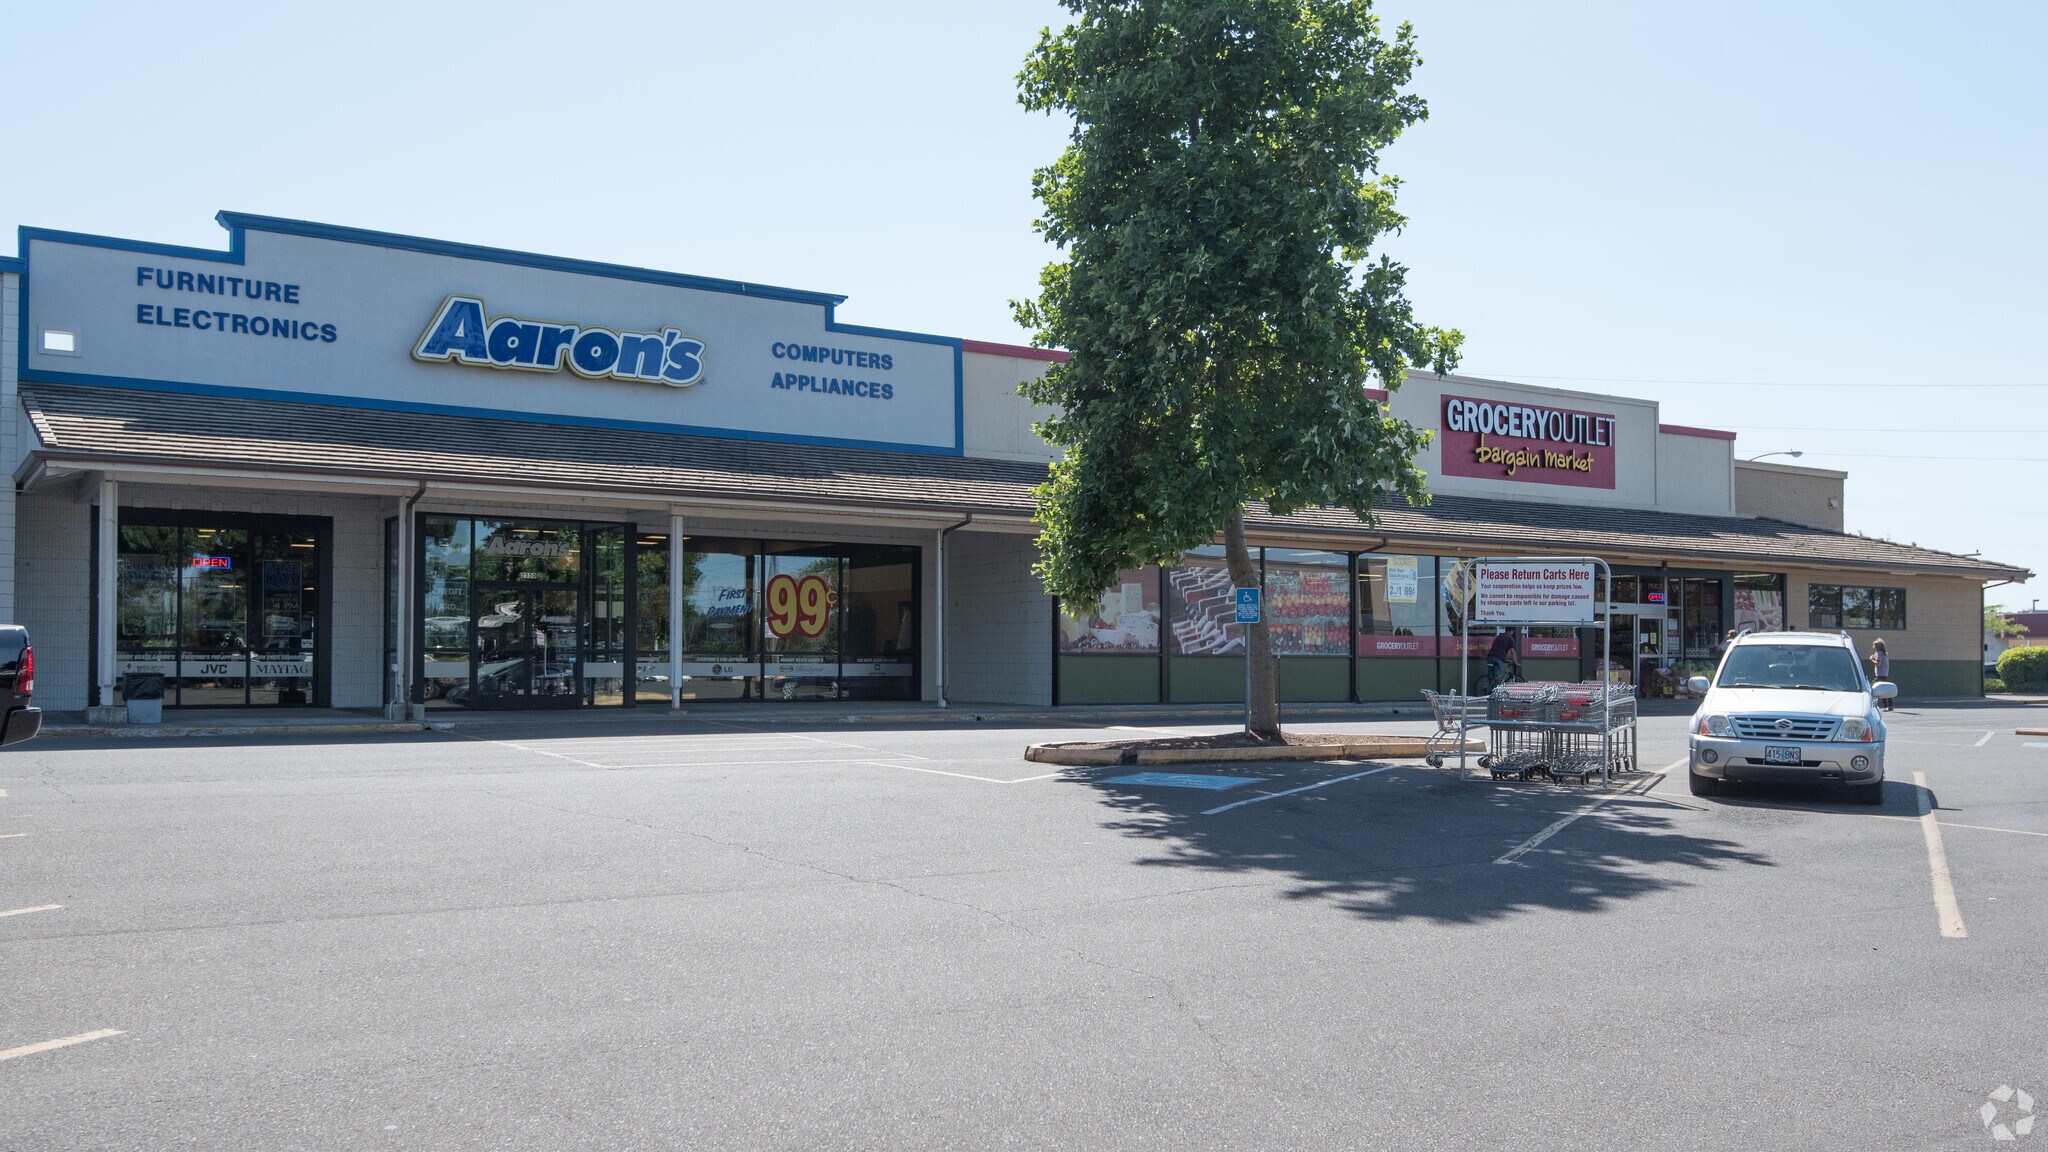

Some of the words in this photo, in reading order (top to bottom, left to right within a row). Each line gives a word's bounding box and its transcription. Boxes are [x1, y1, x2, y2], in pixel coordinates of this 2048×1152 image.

[137, 266, 300, 304] FURNITURE
[136, 303, 337, 343] ELECTRONICS
[413, 294, 705, 387] Aaron's
[771, 341, 893, 371] COMPUTERS
[770, 372, 894, 400] APPLIANCES
[1447, 399, 1616, 447] GROCERYOUTLET
[1475, 432, 1540, 476] bargain
[1544, 448, 1594, 473] market
[487, 534, 569, 557] Aaron's
[192, 557, 229, 568] OPEN
[1481, 568, 1509, 580] Please
[1512, 568, 1540, 580] Return
[1544, 568, 1567, 580] Carts
[1569, 568, 1589, 580] Here
[718, 588, 747, 602] FIRST
[707, 602, 755, 618] PAYMENT
[201, 664, 228, 674] JVC
[256, 665, 308, 674] MAYTAG
[1766, 749, 1781, 759] 415
